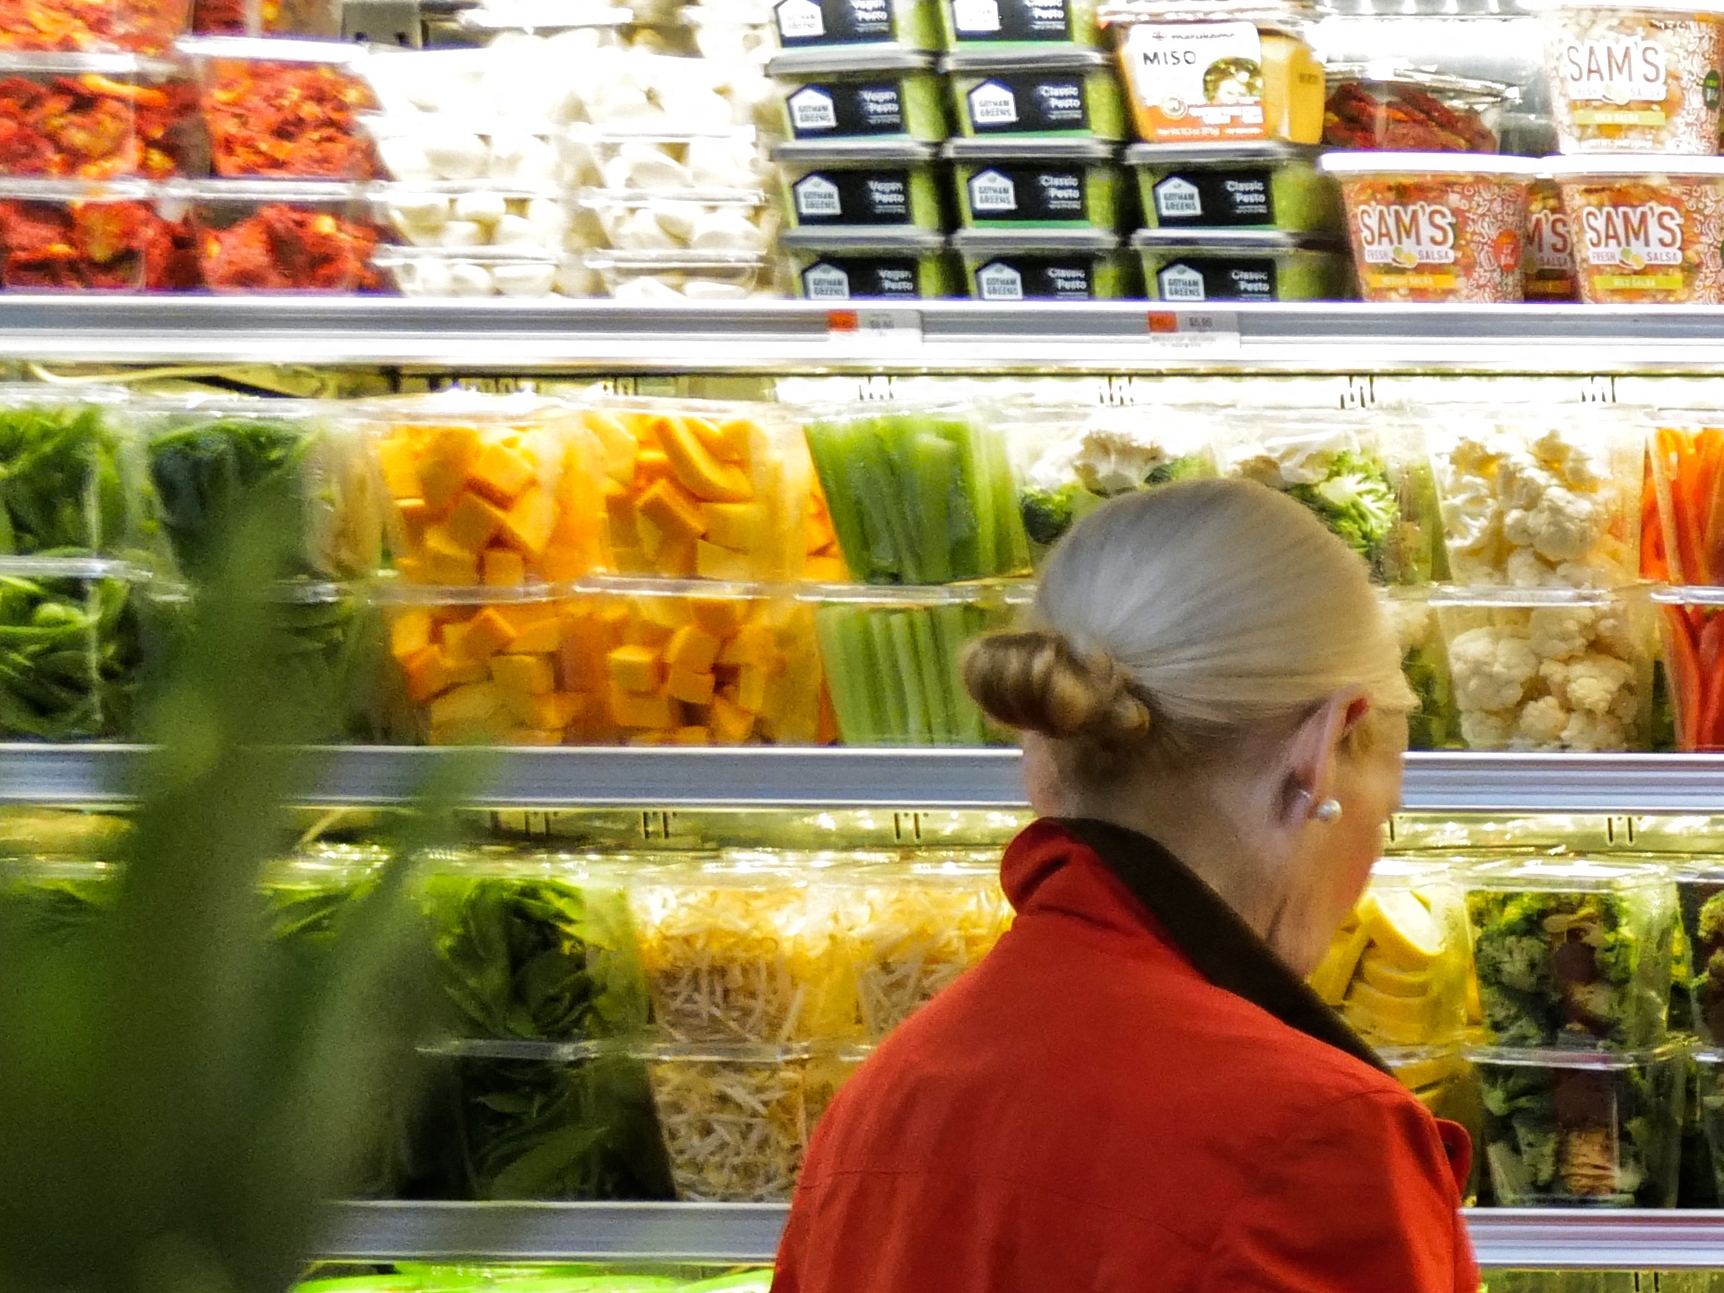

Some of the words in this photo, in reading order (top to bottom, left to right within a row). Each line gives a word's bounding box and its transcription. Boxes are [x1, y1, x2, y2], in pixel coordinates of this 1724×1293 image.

[1143, 50, 1196, 65] MISO
[1567, 43, 1661, 82] SAM'S
[1359, 205, 1451, 246] SAM'S
[1584, 206, 1676, 245] SAM'S
